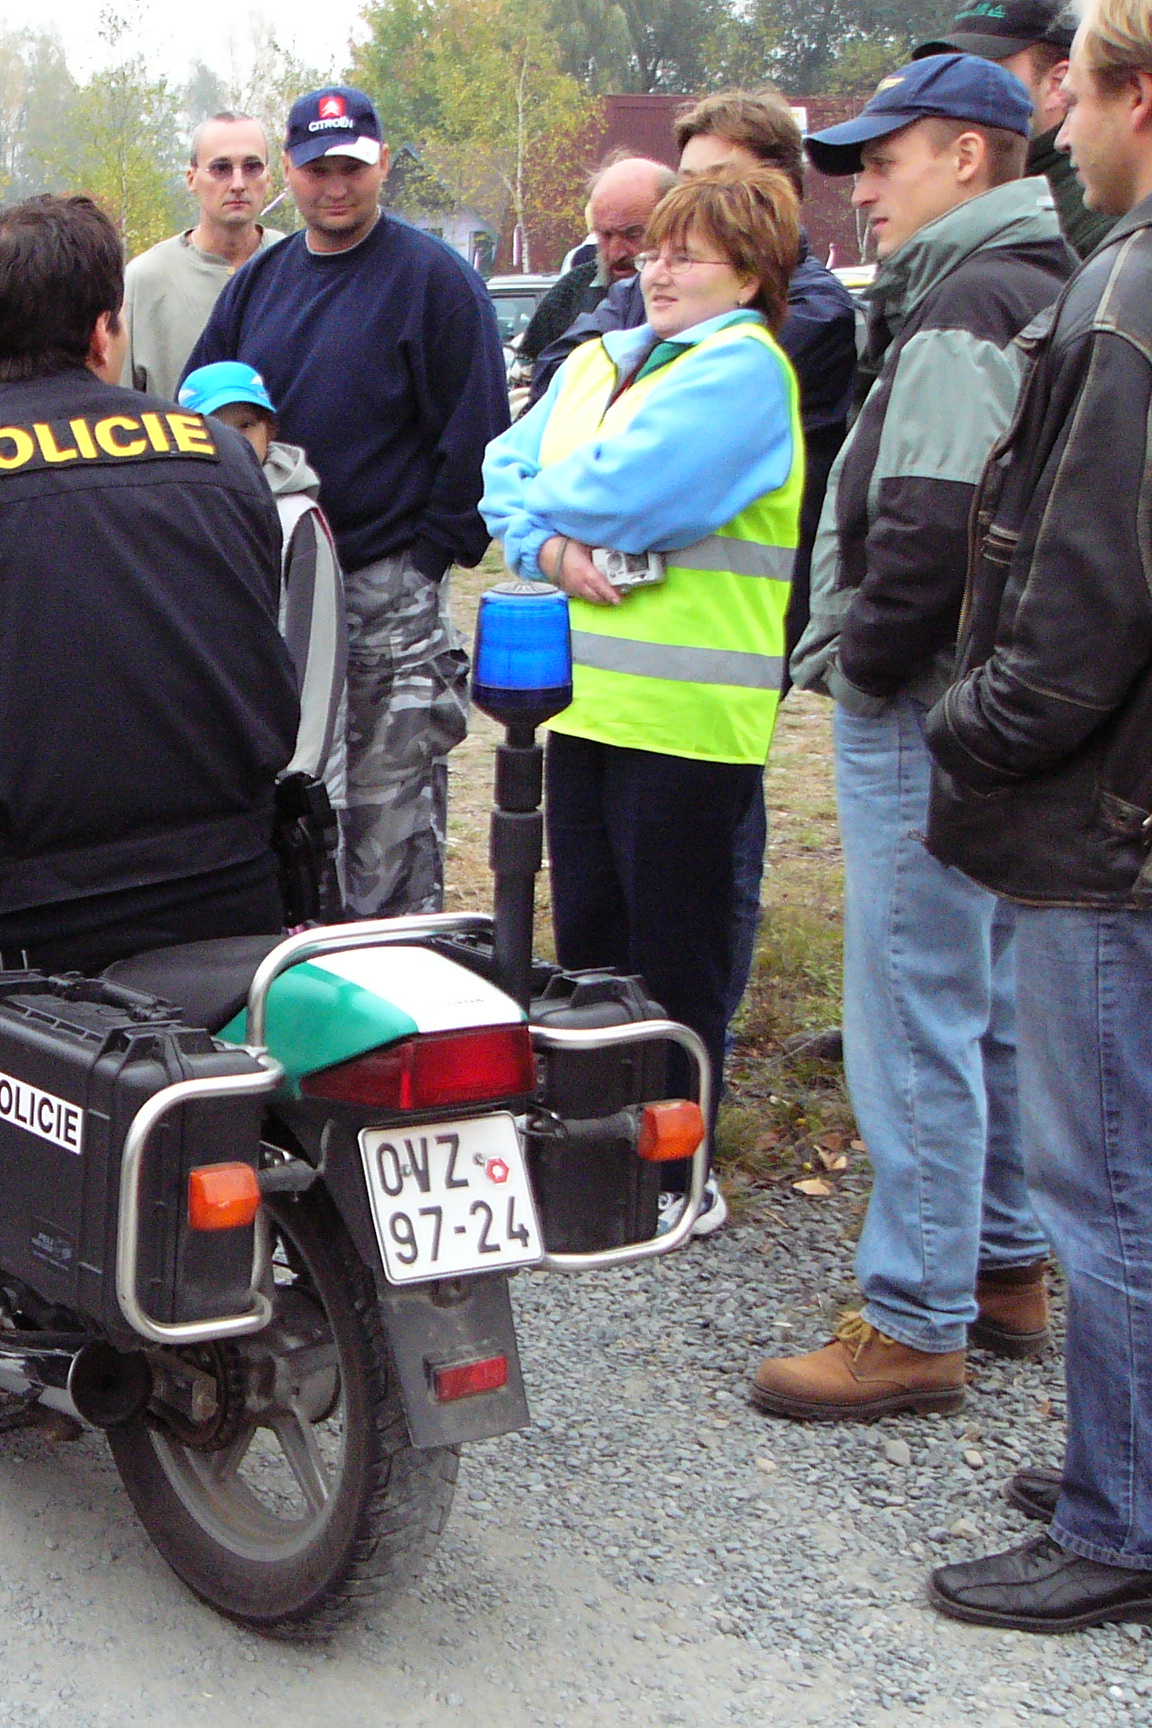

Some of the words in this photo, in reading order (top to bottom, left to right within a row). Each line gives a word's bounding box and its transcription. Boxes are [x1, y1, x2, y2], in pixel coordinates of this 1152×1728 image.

[308, 116, 353, 132] CITROËN
[375, 1131, 470, 1197] OVZ
[388, 1195, 530, 1265] 97-24
